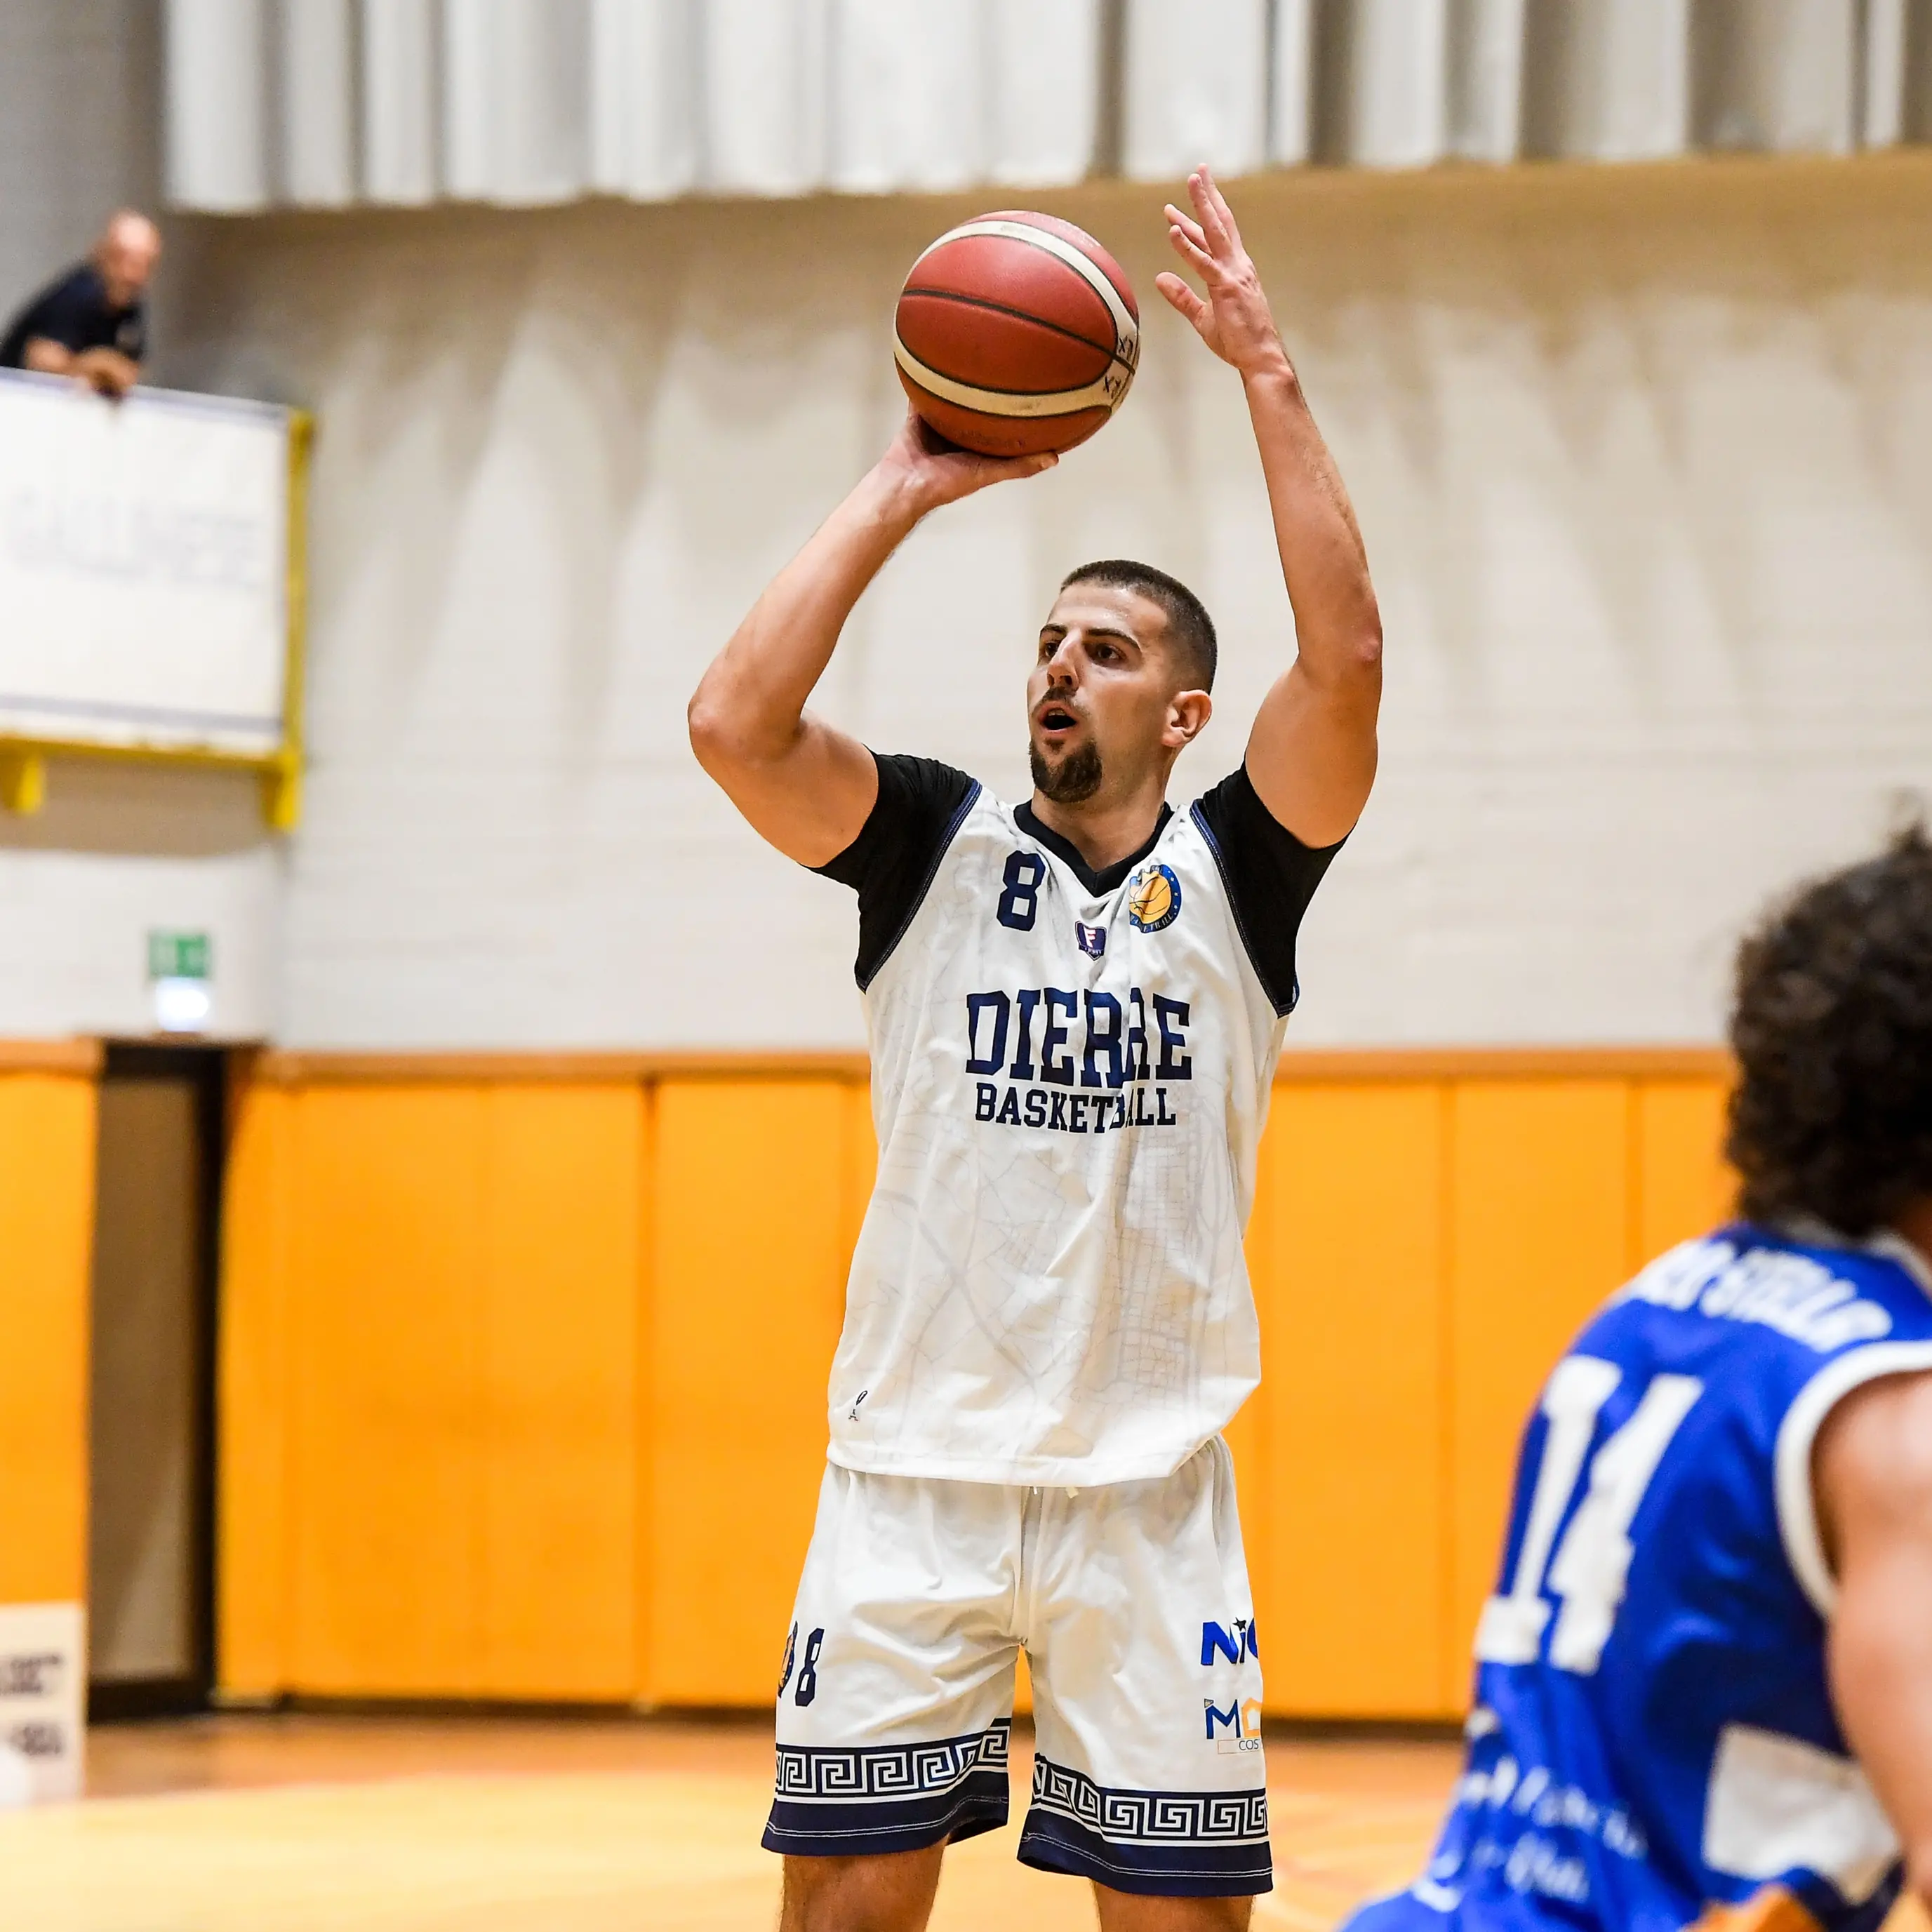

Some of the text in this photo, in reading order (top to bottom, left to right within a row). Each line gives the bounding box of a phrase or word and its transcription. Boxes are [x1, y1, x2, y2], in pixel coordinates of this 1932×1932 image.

[997, 850, 1046, 931] 8
[966, 987, 1192, 1088] DIERRE
[1474, 1354, 1705, 1676] 14
[1239, 1738, 1260, 1750] COS
